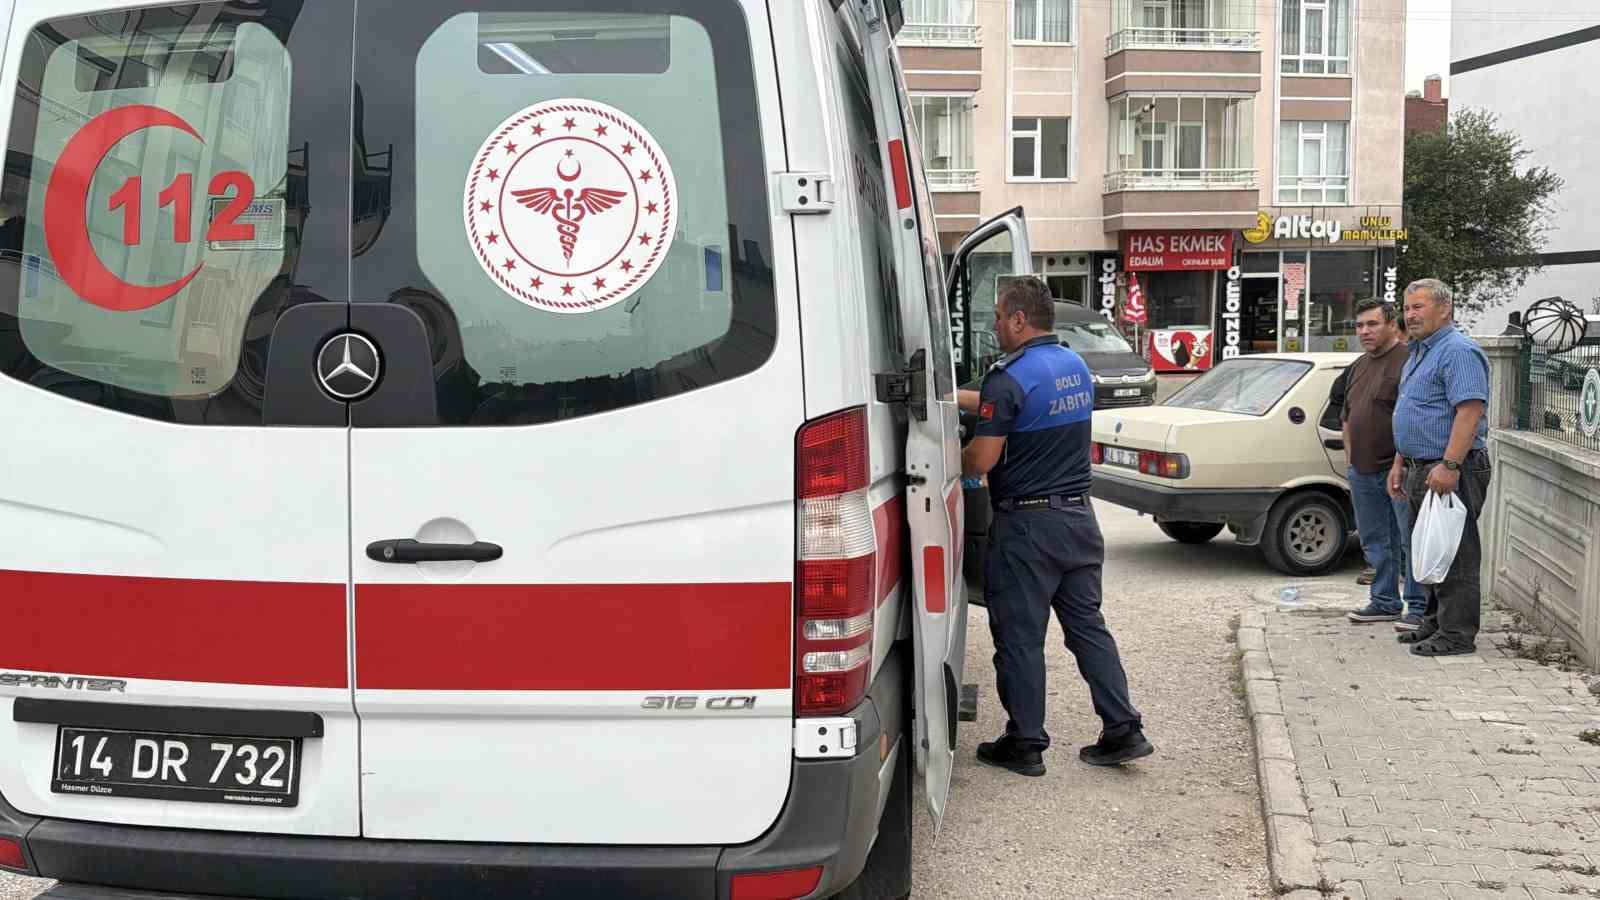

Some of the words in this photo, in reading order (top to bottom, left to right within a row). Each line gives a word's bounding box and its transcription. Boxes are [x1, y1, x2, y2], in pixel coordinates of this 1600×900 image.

[108, 170, 256, 246] 112
[1274, 214, 1341, 243] Altay
[1130, 236, 1165, 253] HAS
[1170, 235, 1226, 252] EKMEK
[1222, 265, 1241, 361] Bazlama
[1055, 373, 1081, 391] BOLU
[1049, 391, 1091, 415] ZABITA
[0, 673, 127, 692] SPRINTER
[640, 695, 699, 710] 316
[705, 695, 757, 710] CDI
[71, 735, 113, 777] 14
[131, 738, 190, 782] DR
[209, 742, 285, 788] 732
[61, 783, 89, 793] Hasmer
[90, 784, 113, 794] Düzce
